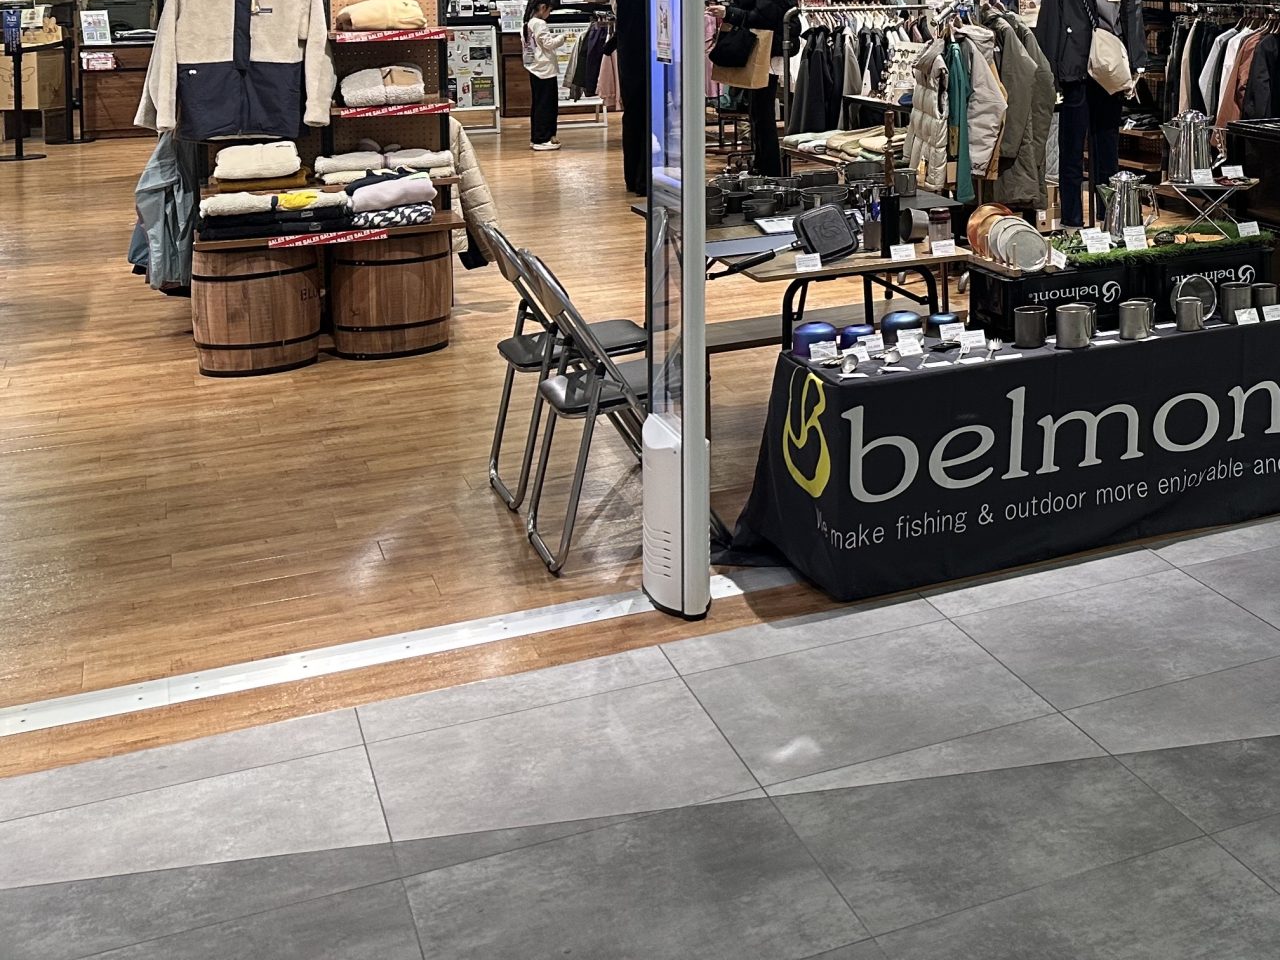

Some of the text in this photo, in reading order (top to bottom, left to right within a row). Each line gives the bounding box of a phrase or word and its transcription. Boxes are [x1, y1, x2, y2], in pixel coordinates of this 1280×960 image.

[830, 523, 886, 550] make
[895, 509, 968, 539] fishing
[978, 503, 994, 526] &
[1004, 491, 1087, 521] outdoor
[1096, 481, 1149, 506] more
[1157, 456, 1244, 495] enjoyable
